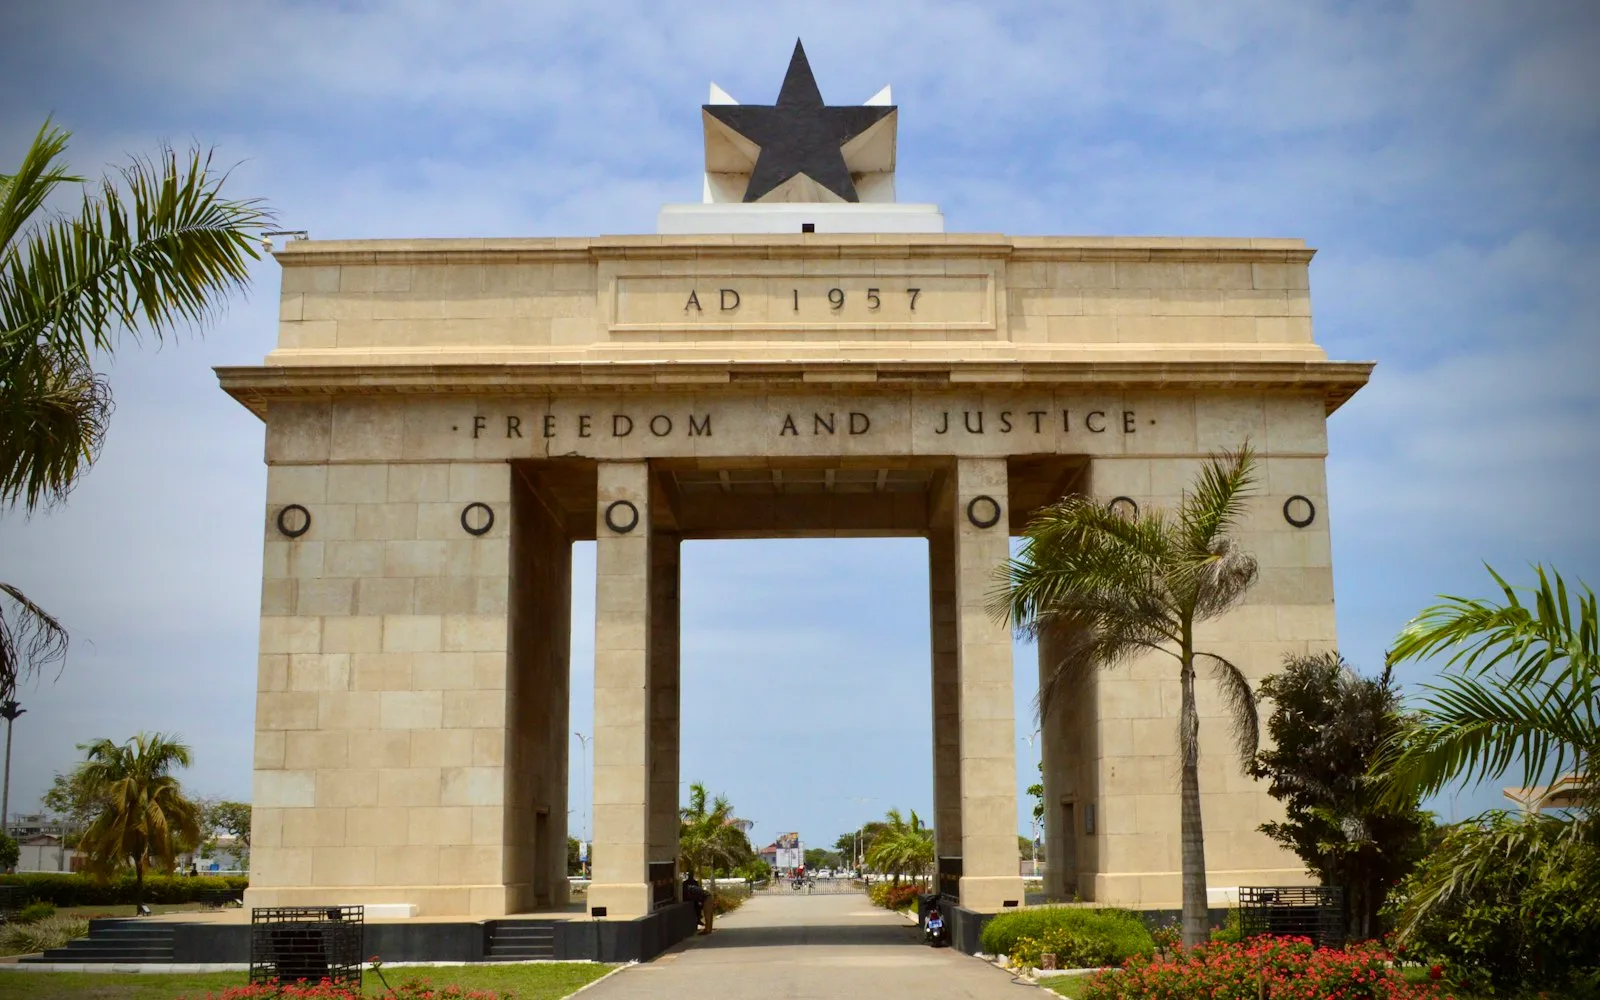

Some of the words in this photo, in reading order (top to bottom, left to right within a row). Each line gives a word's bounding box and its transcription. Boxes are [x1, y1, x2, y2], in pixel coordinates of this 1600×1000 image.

[684, 289, 740, 312] AD
[793, 288, 921, 311] 1957
[779, 411, 870, 437] AND
